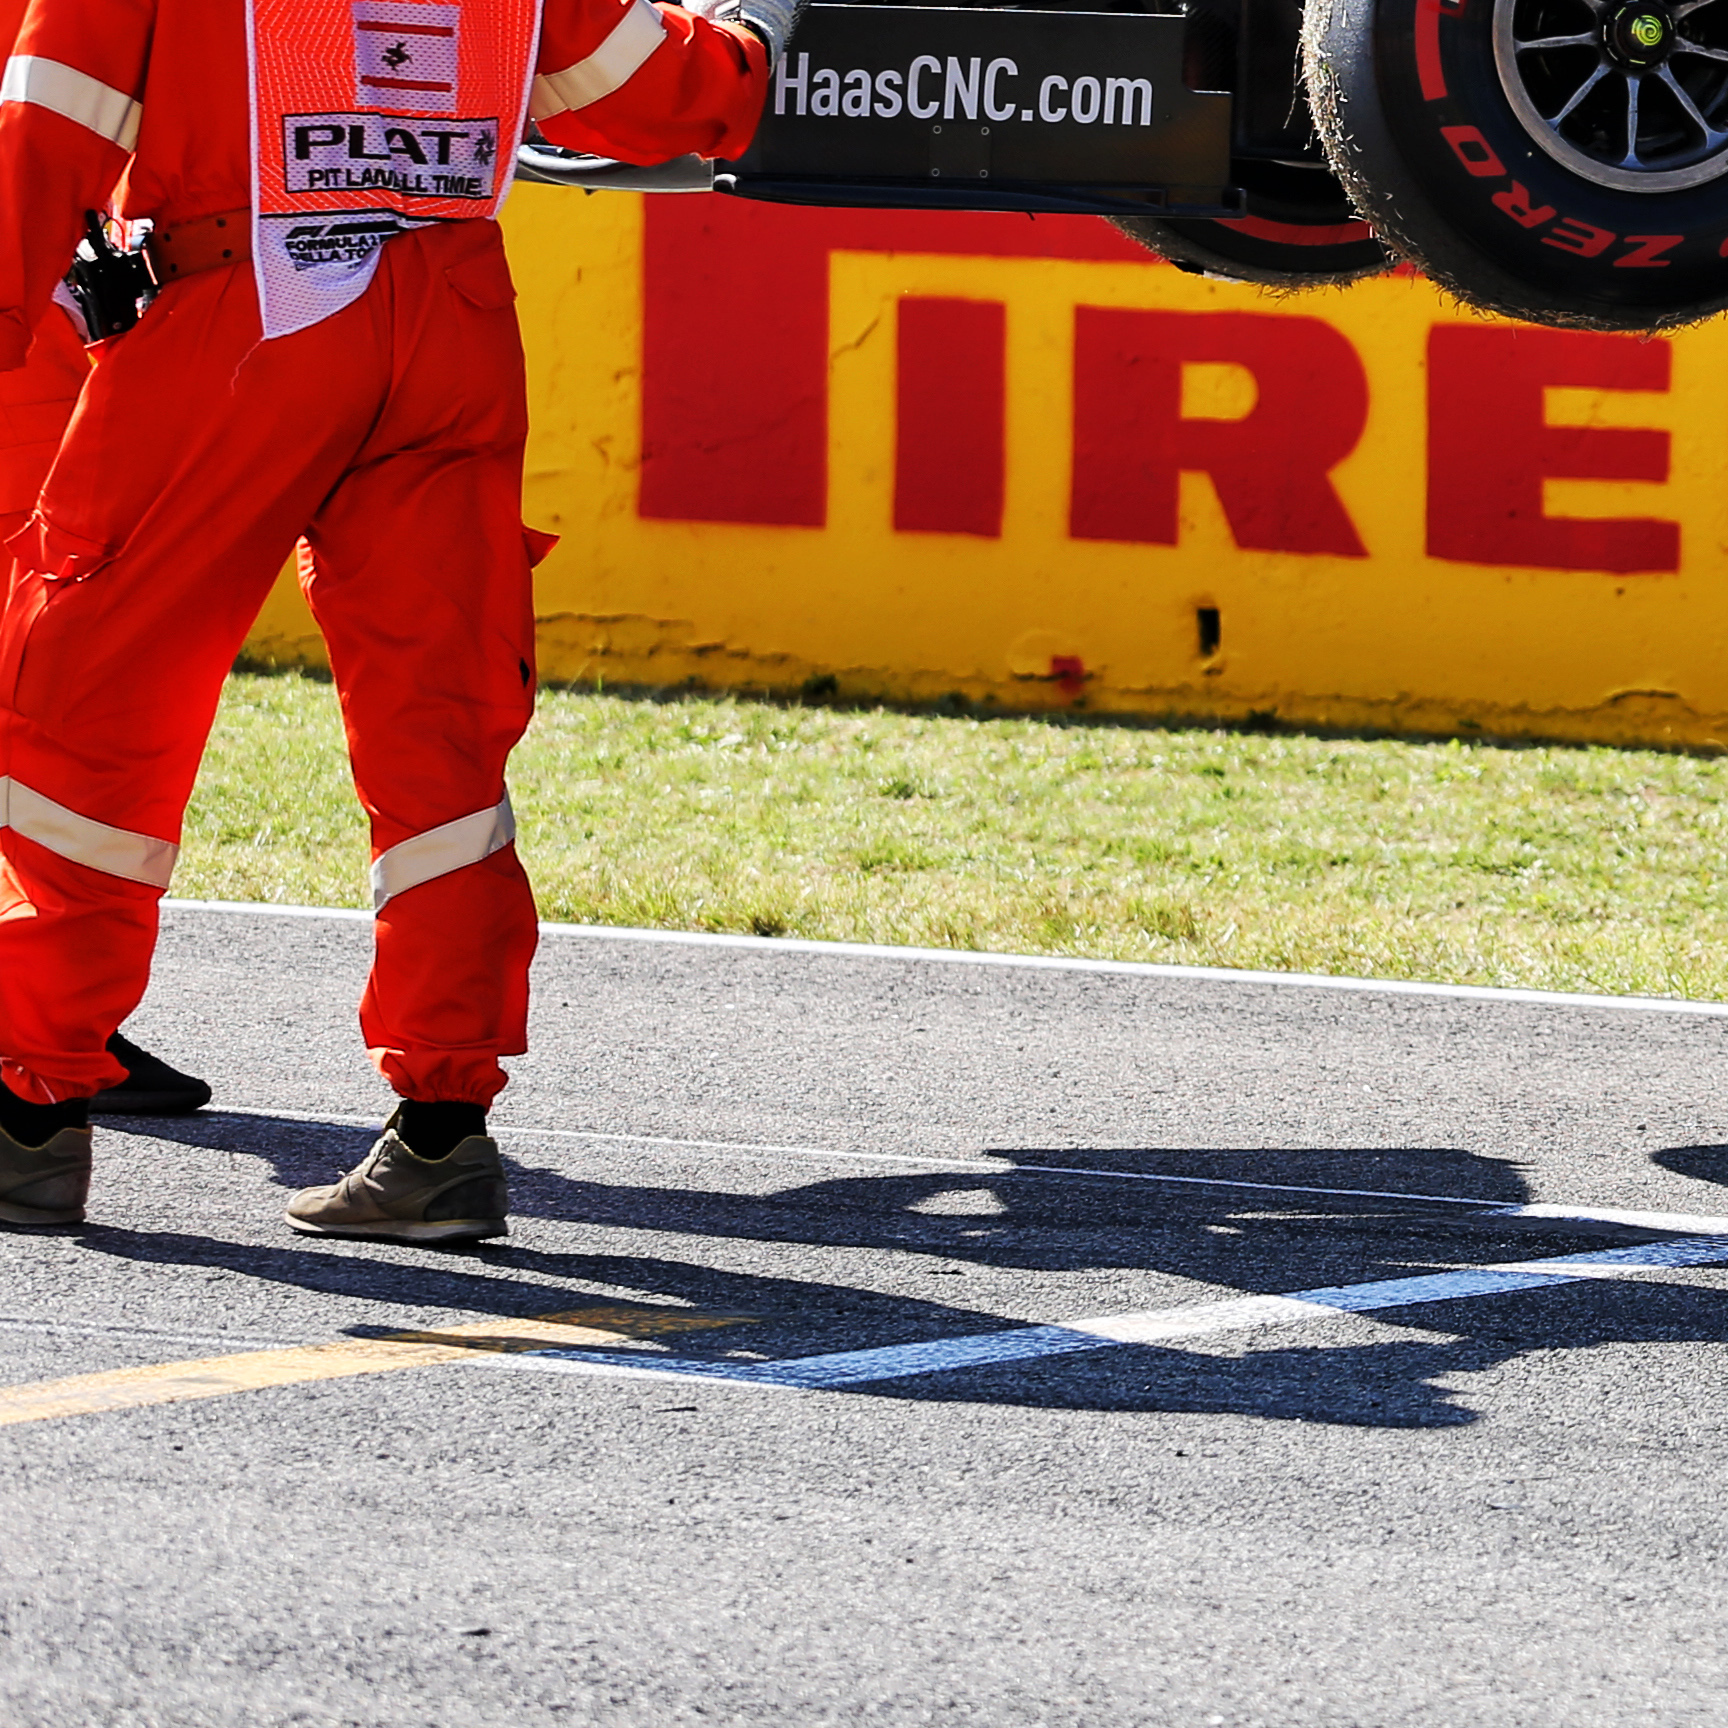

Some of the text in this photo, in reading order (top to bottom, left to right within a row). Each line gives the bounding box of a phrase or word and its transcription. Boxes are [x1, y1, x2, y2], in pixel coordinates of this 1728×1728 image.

[774, 51, 1154, 128] HaasCNC.com
[295, 125, 469, 165] PLAT
[308, 169, 340, 188] PIT
[432, 175, 483, 196] TIME
[1439, 124, 1685, 268] ZERO
[285, 234, 367, 252] FORMULA
